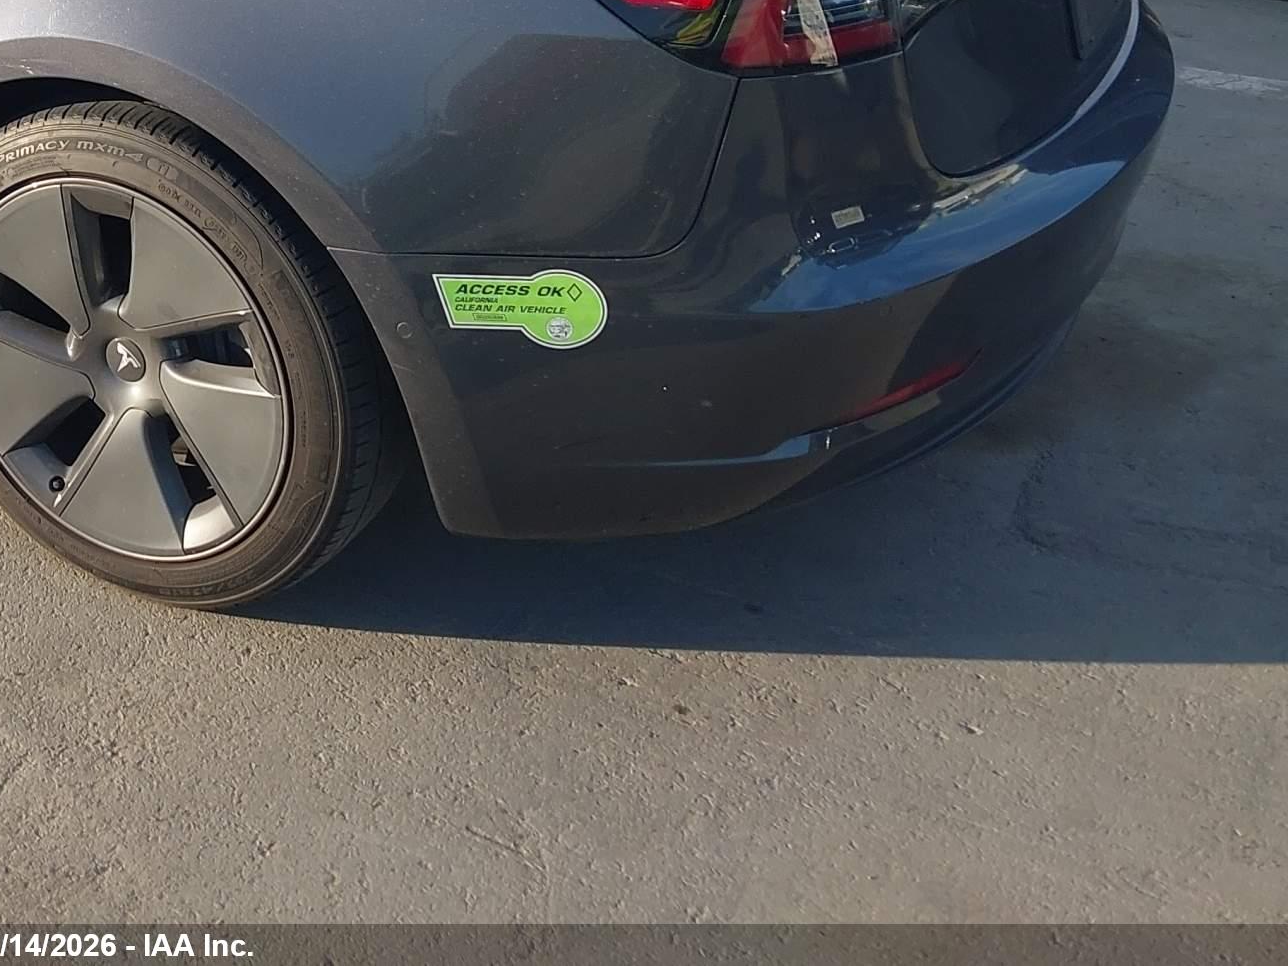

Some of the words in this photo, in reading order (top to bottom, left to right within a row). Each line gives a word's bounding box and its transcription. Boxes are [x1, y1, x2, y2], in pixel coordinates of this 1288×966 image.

[455, 284, 531, 296] ACCESS
[537, 286, 565, 297] OK
[455, 303, 492, 312] CLEAN
[495, 305, 516, 313] AIR
[520, 305, 567, 314] VEHICLE
